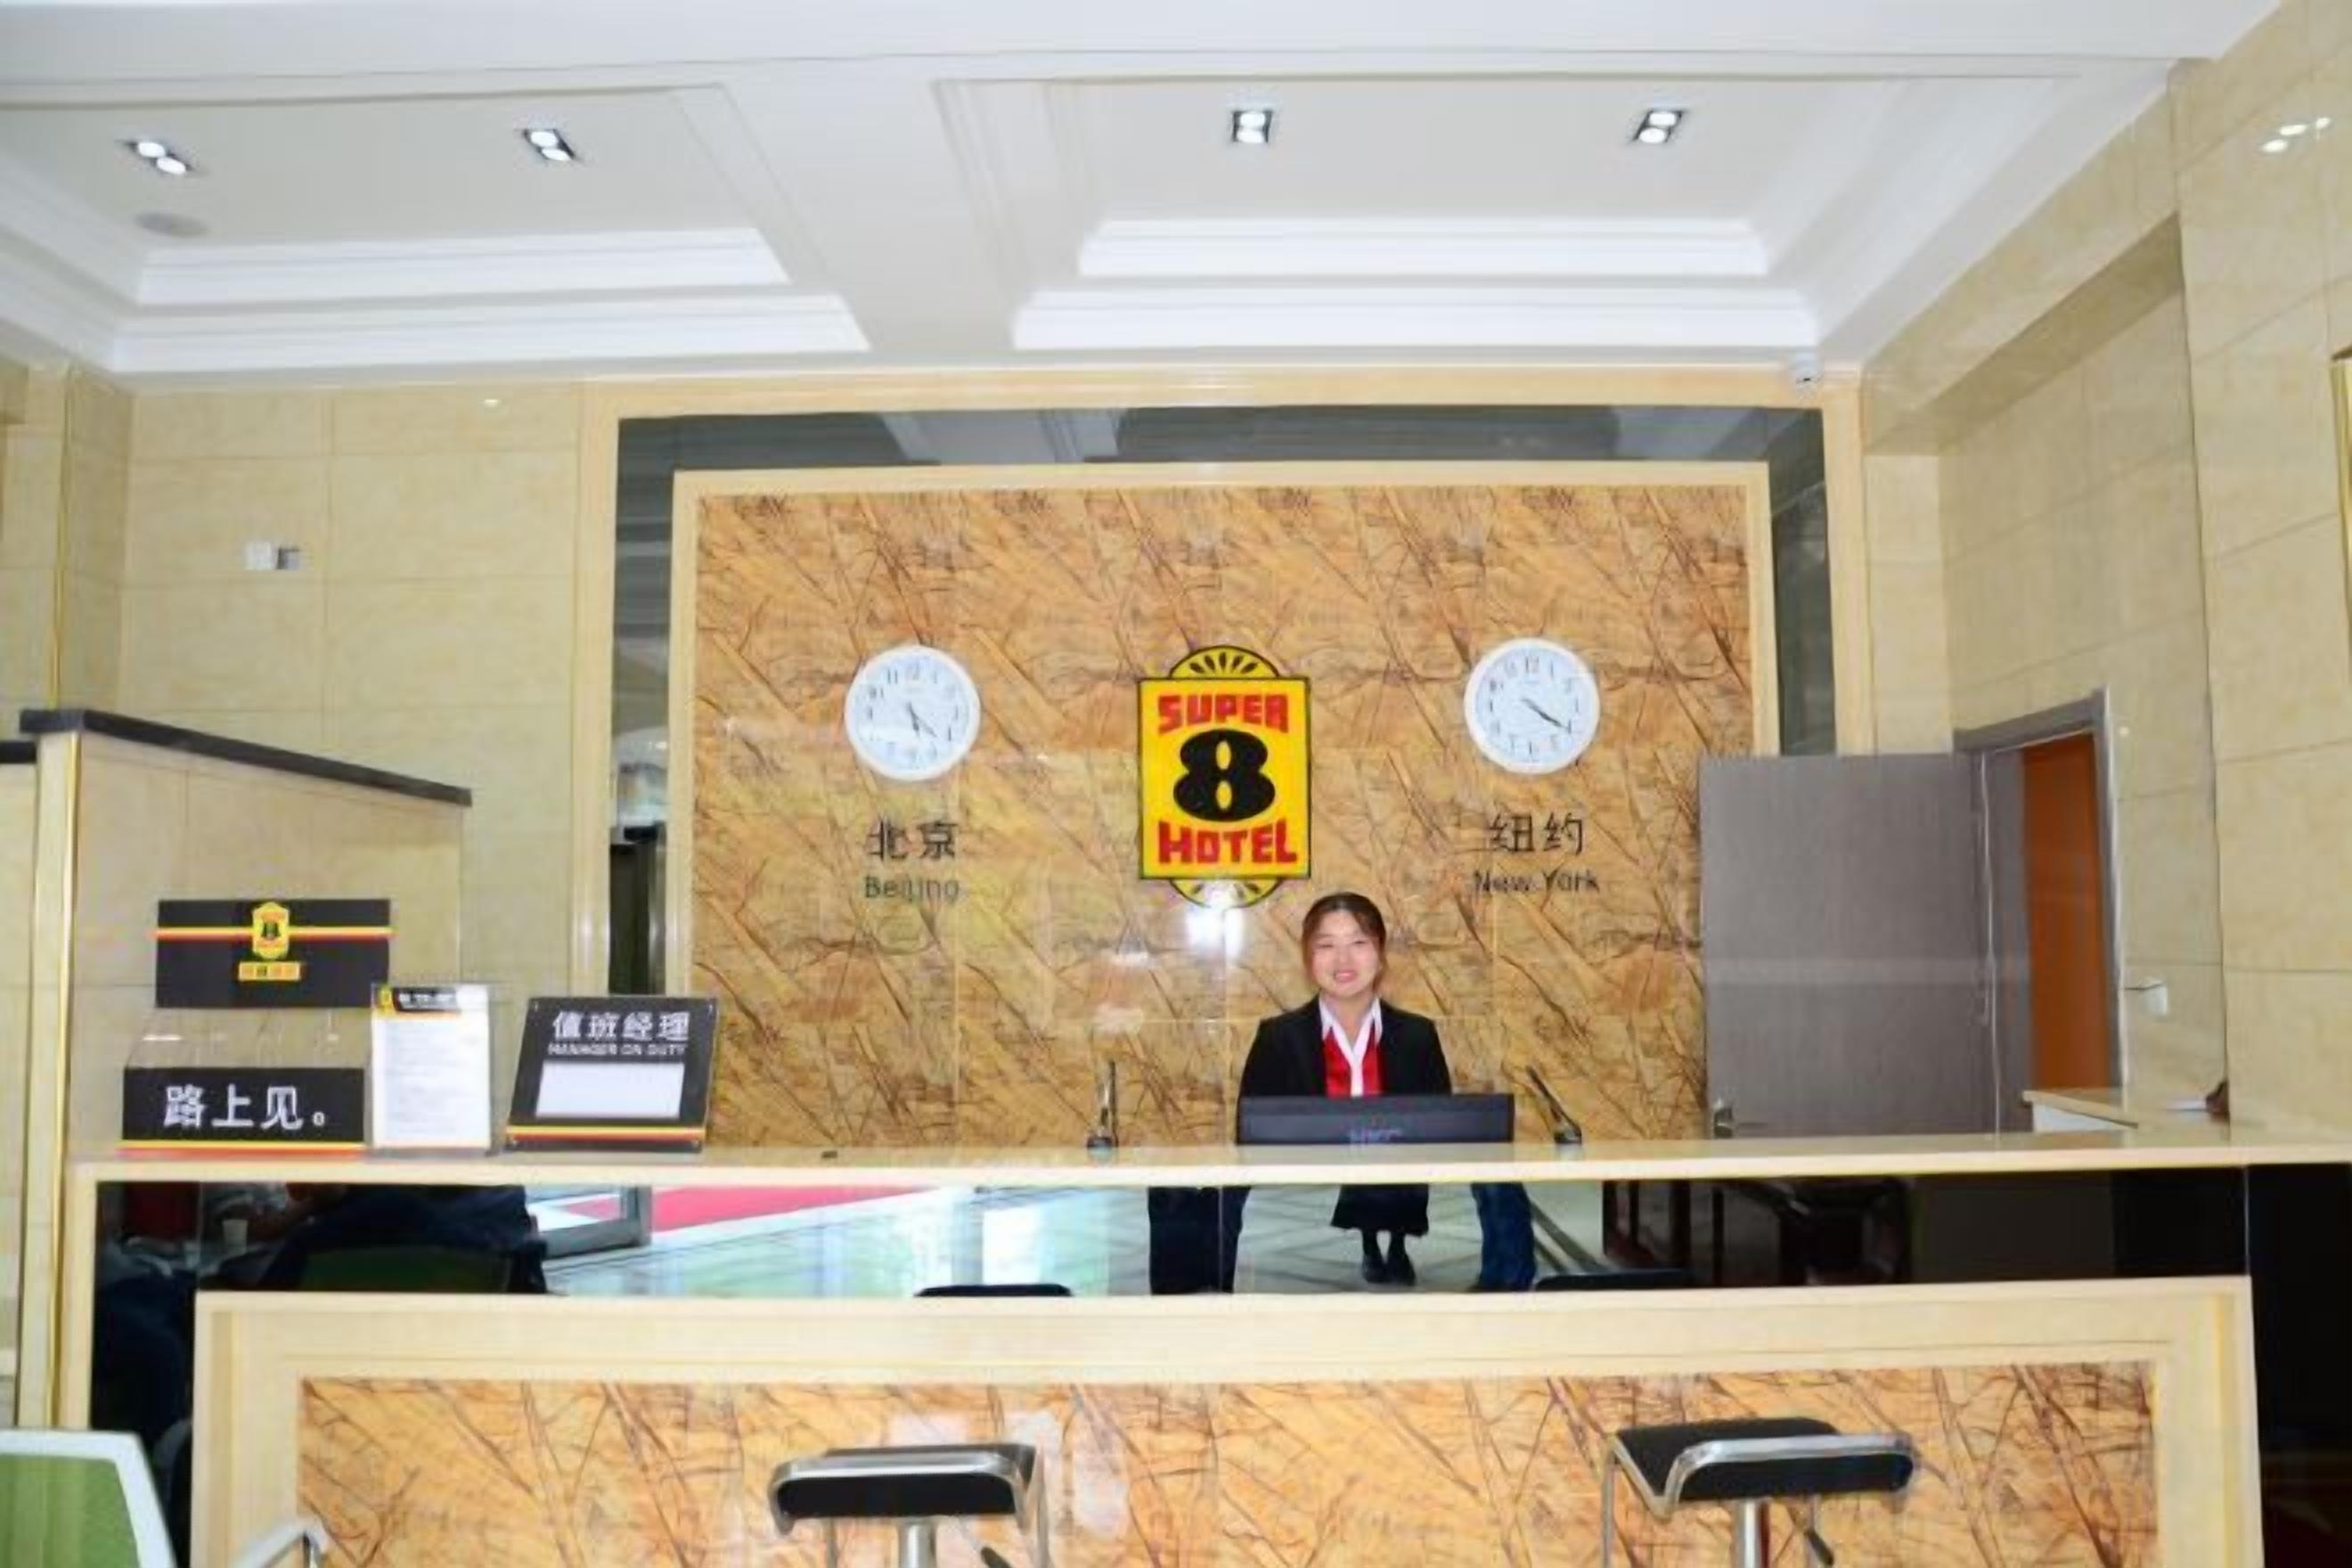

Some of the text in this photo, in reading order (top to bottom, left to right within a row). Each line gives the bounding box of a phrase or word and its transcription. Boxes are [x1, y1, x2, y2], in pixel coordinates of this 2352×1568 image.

[1157, 694, 1289, 735] SUPER
[1173, 729, 1276, 822] 8
[866, 816, 958, 862] 北京
[1158, 819, 1297, 863] HOTEL
[1490, 812, 1583, 855] 纽约
[552, 1010, 690, 1041] 值班经理
[164, 1082, 326, 1131] 路上见。
